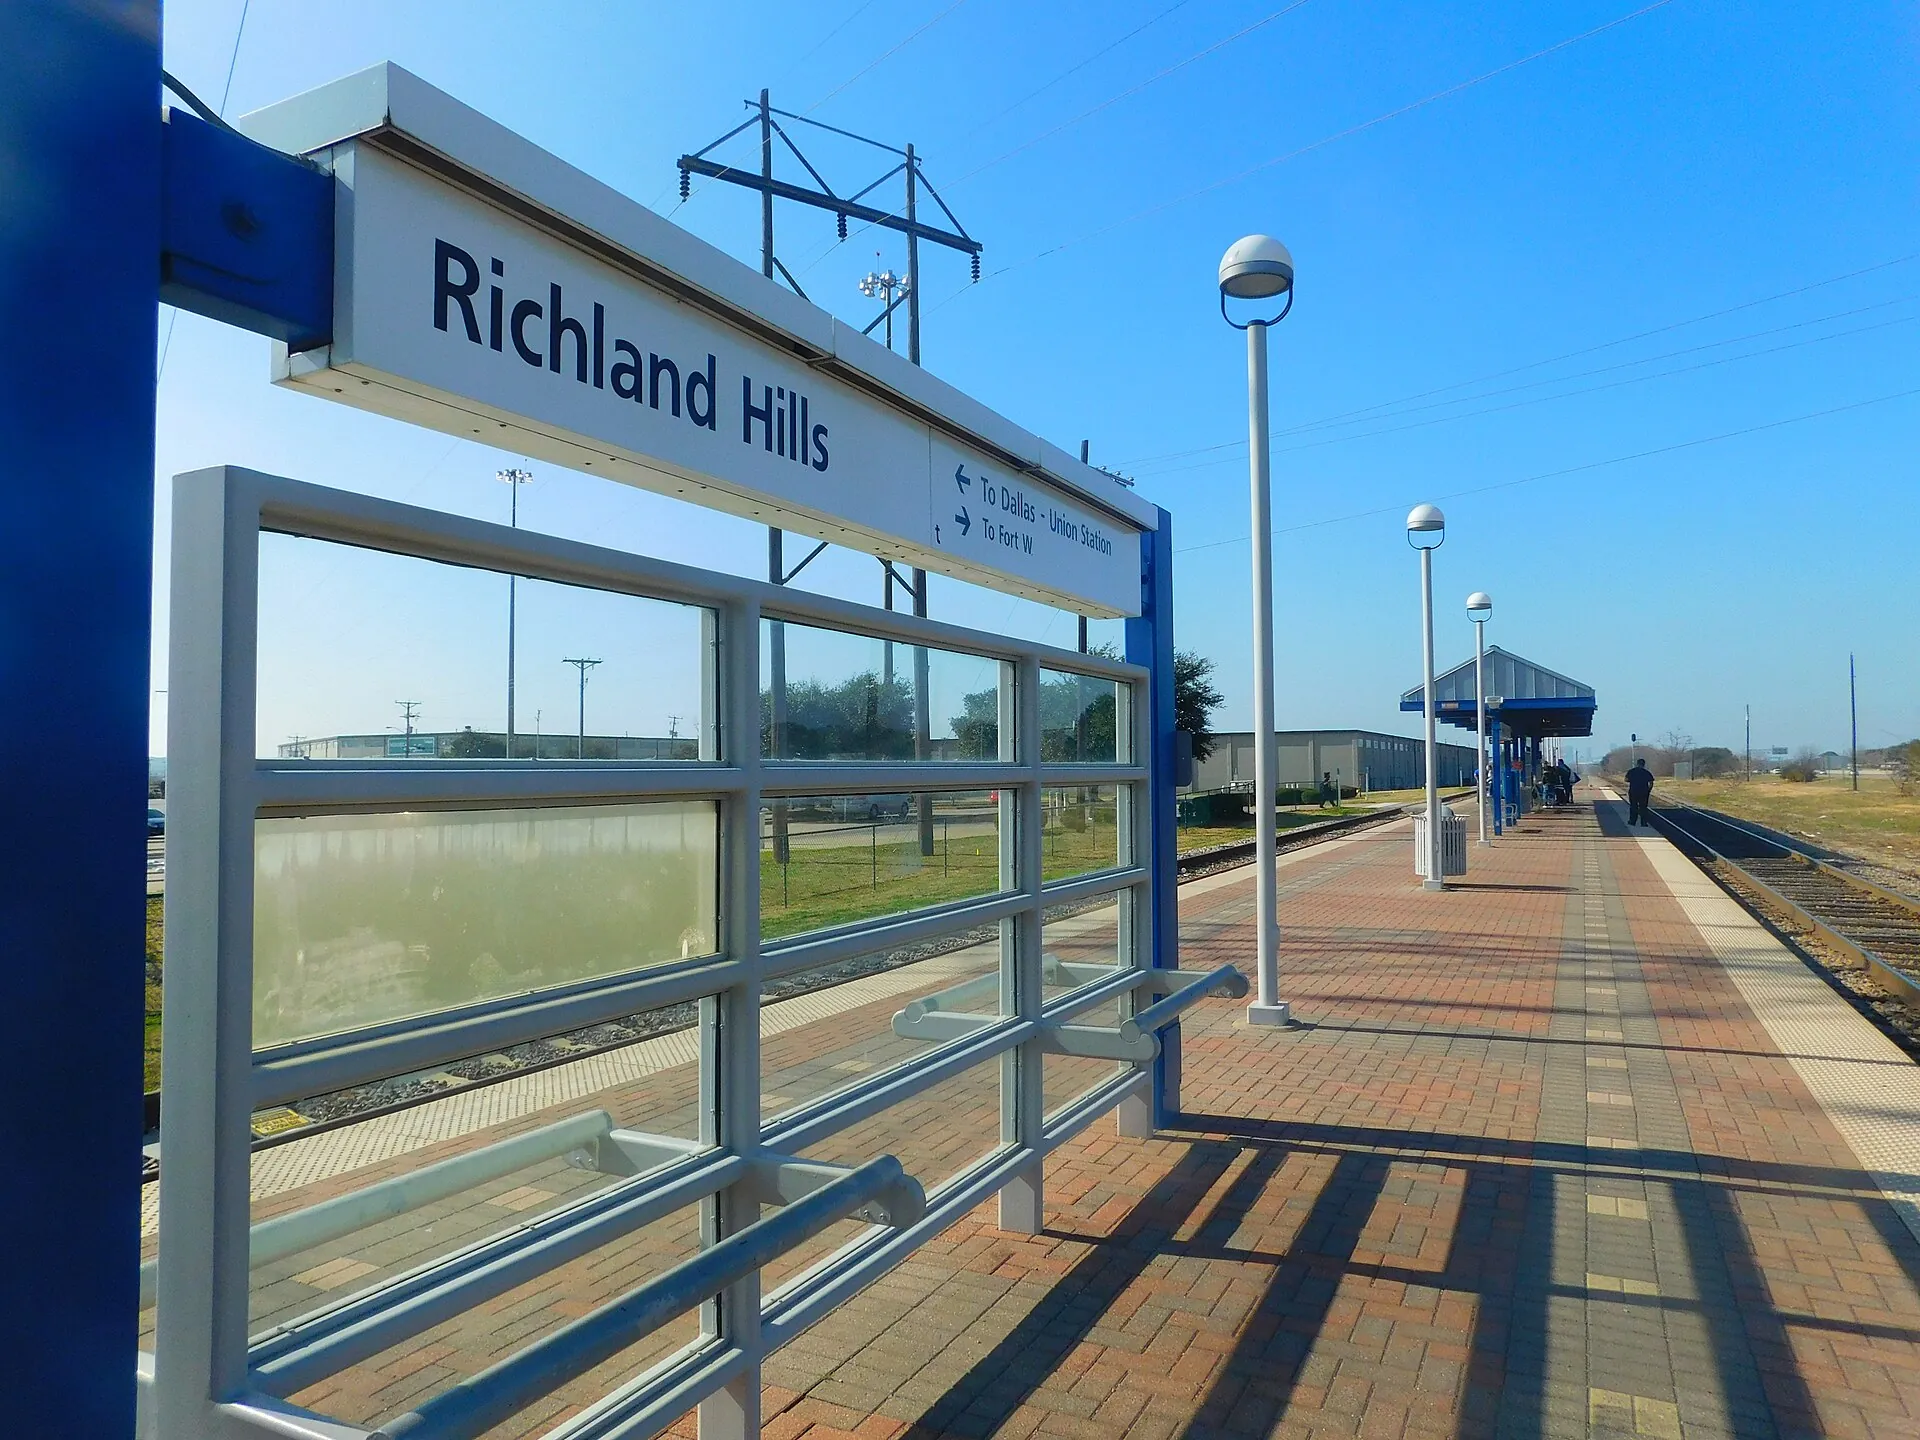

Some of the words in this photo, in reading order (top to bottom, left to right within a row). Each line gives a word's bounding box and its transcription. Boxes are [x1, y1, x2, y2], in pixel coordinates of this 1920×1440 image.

[433, 237, 717, 431] Richland
[742, 375, 829, 472] Hills
[980, 476, 996, 505] To
[1001, 486, 1036, 523] Dallas
[1049, 508, 1078, 541] Union
[1080, 524, 1112, 556] Station
[982, 517, 995, 541] To
[999, 525, 1019, 550] Fort
